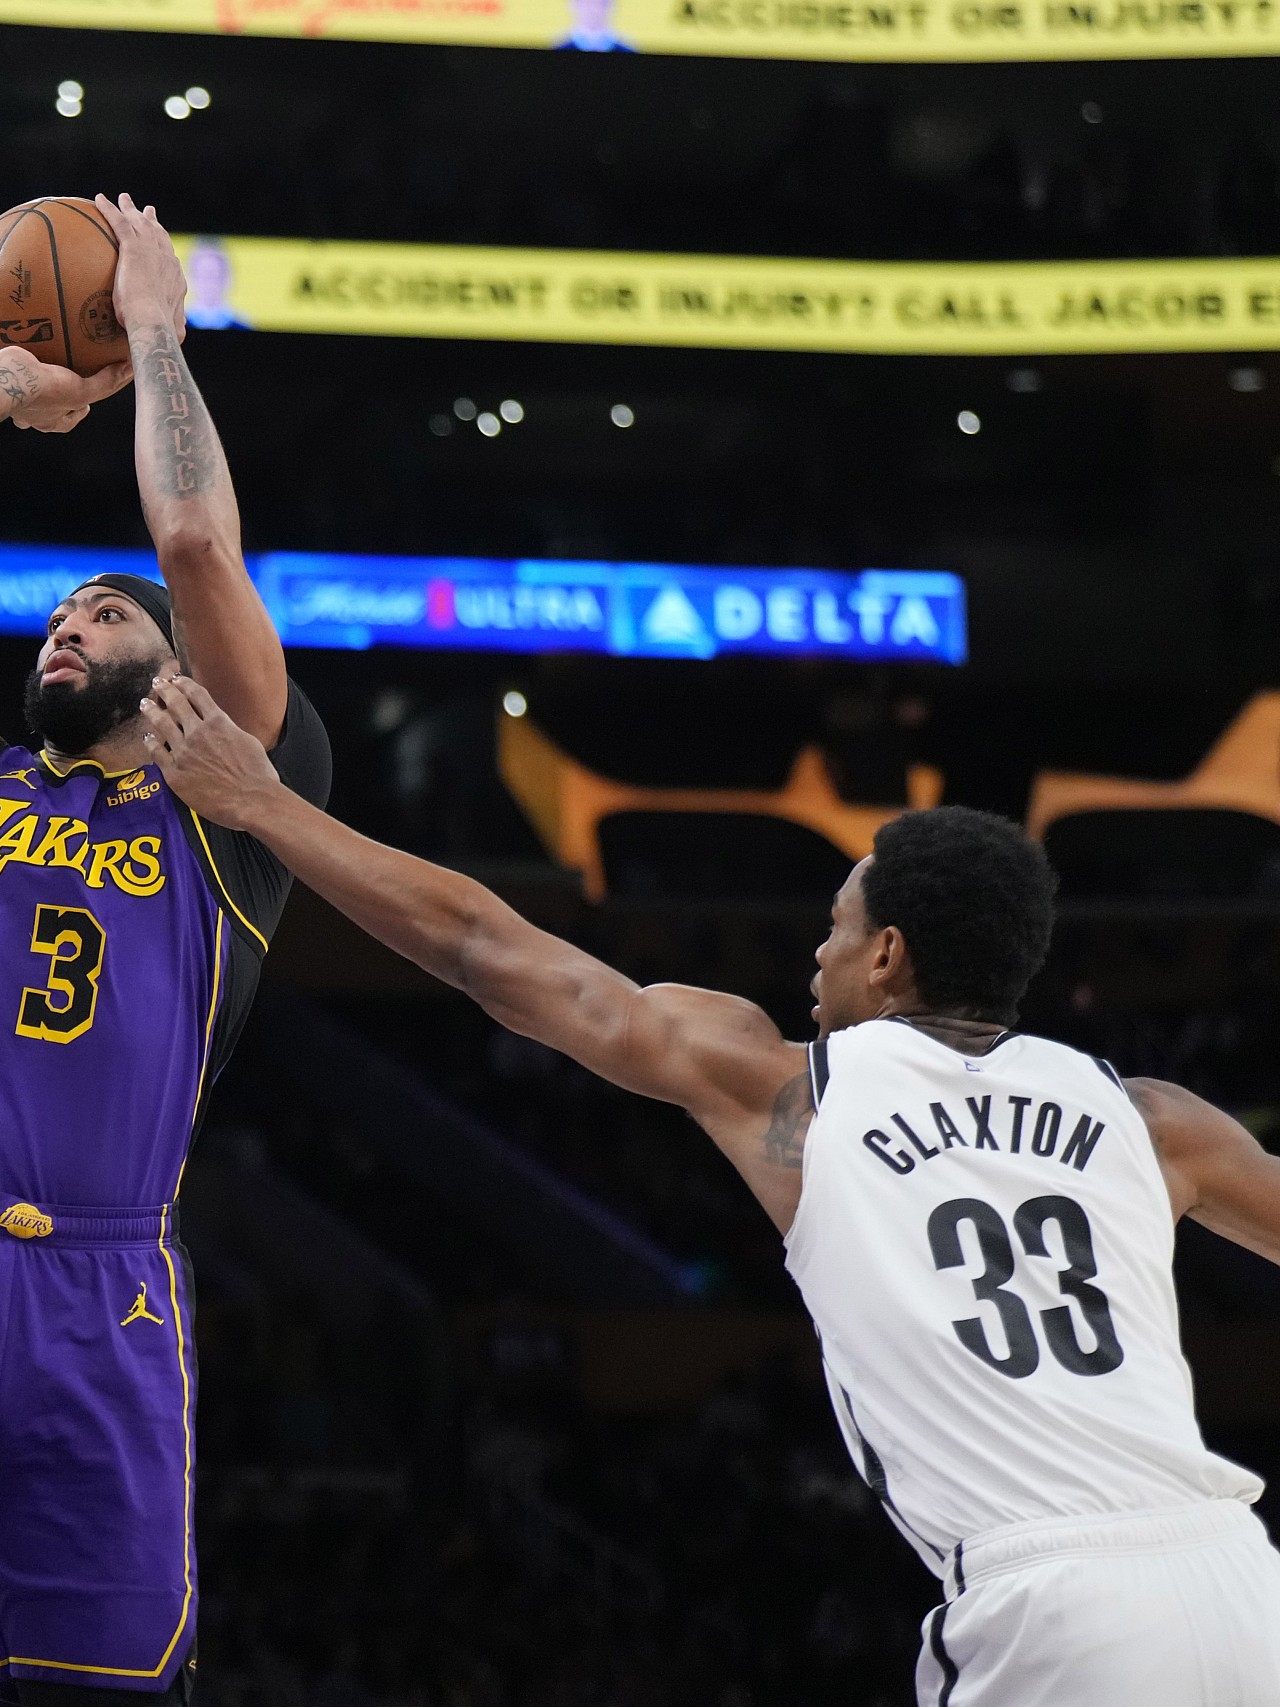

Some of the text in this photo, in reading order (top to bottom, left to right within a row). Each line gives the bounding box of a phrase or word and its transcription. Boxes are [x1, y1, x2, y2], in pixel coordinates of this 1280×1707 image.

[290, 266, 552, 313] ACCIDENT
[567, 273, 642, 318] OR
[893, 283, 1022, 330] CALL
[1046, 284, 1227, 329] JACOB
[713, 586, 940, 648] DELTA
[106, 781, 161, 808] bibigo
[15, 903, 107, 1045] 3
[862, 1094, 1106, 1176] CLAXTON
[0, 1209, 50, 1236] LAKERS
[926, 1194, 1125, 1380] 33
